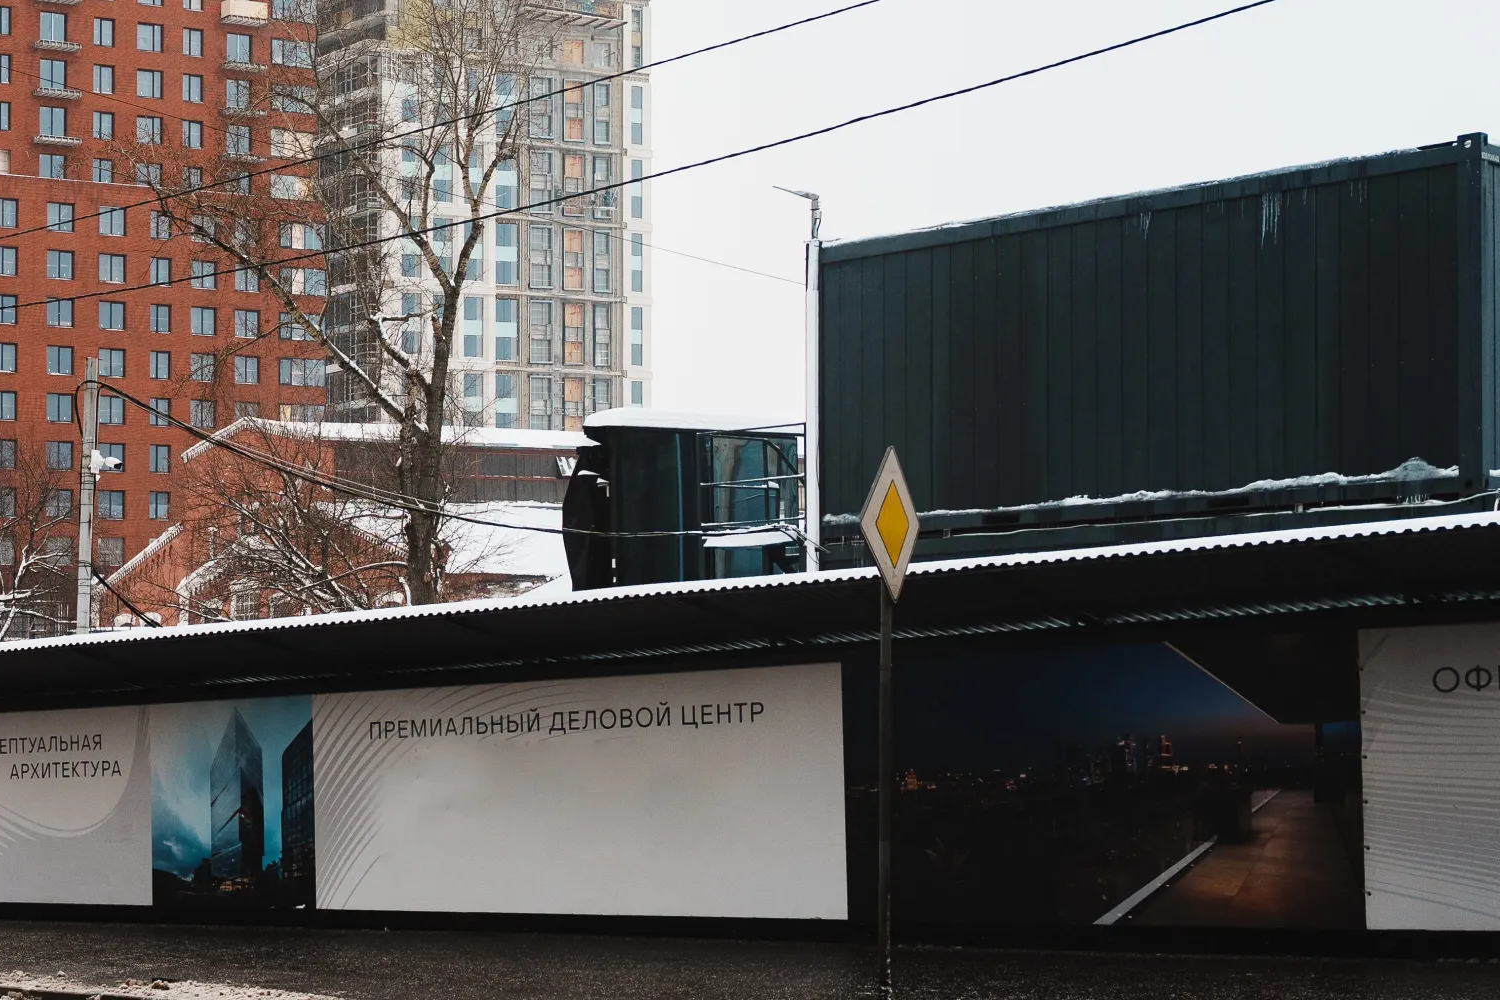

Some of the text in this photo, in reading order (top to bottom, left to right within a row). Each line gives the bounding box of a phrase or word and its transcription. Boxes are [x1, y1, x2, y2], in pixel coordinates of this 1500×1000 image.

[1432, 665, 1500, 693] ОФ
[369, 701, 765, 740] ПРЕМИАЛЬНЫЙ ДЕЛОВОЙ ЦЕНТР
[10, 760, 122, 779] АРХИТЕКТУРА
